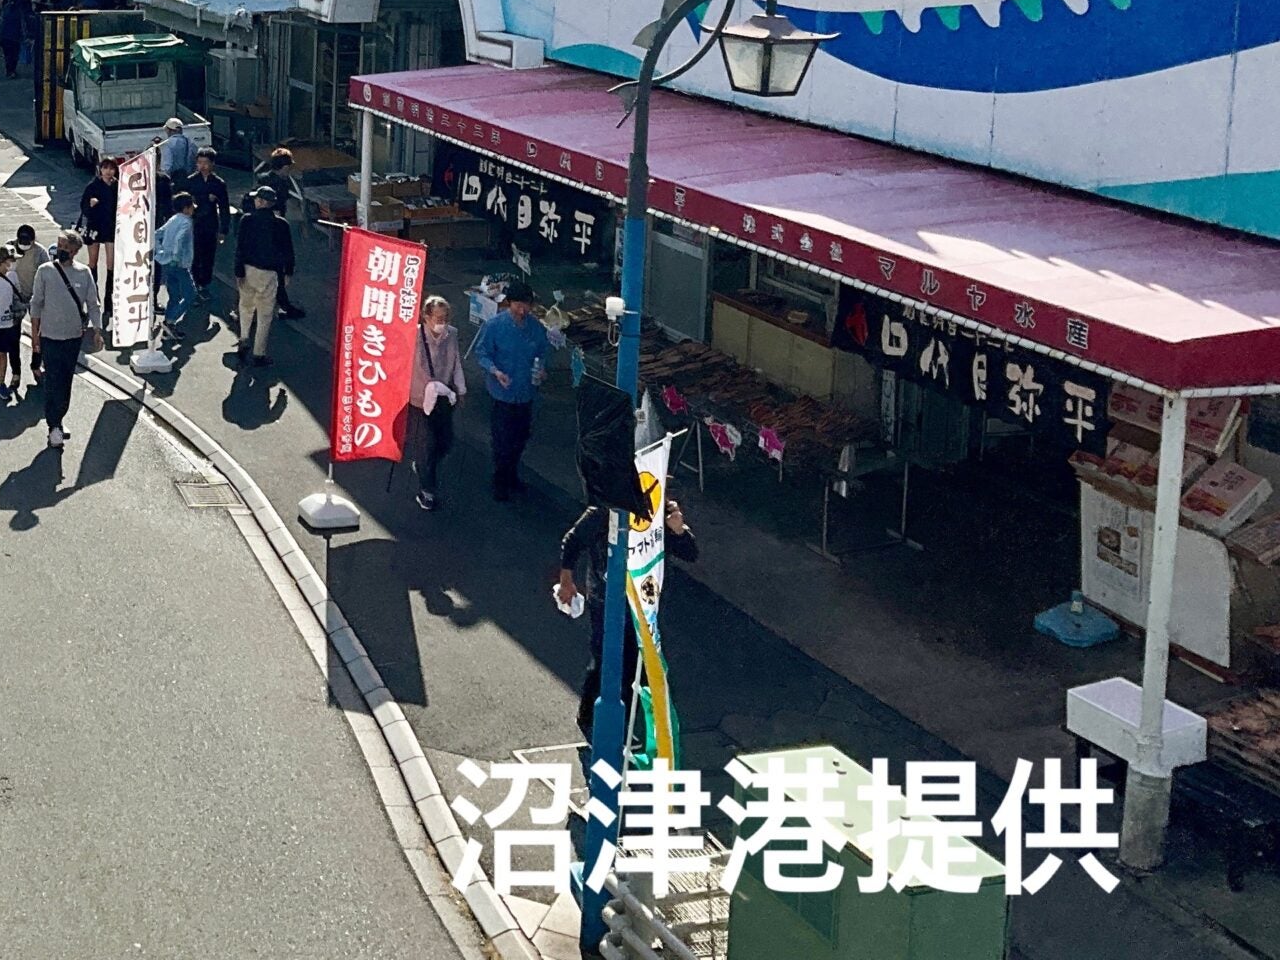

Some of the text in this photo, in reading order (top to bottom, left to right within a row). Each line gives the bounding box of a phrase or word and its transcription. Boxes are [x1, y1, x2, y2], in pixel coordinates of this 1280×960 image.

[461, 172, 596, 254] 四代目弥平
[355, 246, 402, 449] 朝開きひもの
[877, 256, 1090, 351] マルヤ水産
